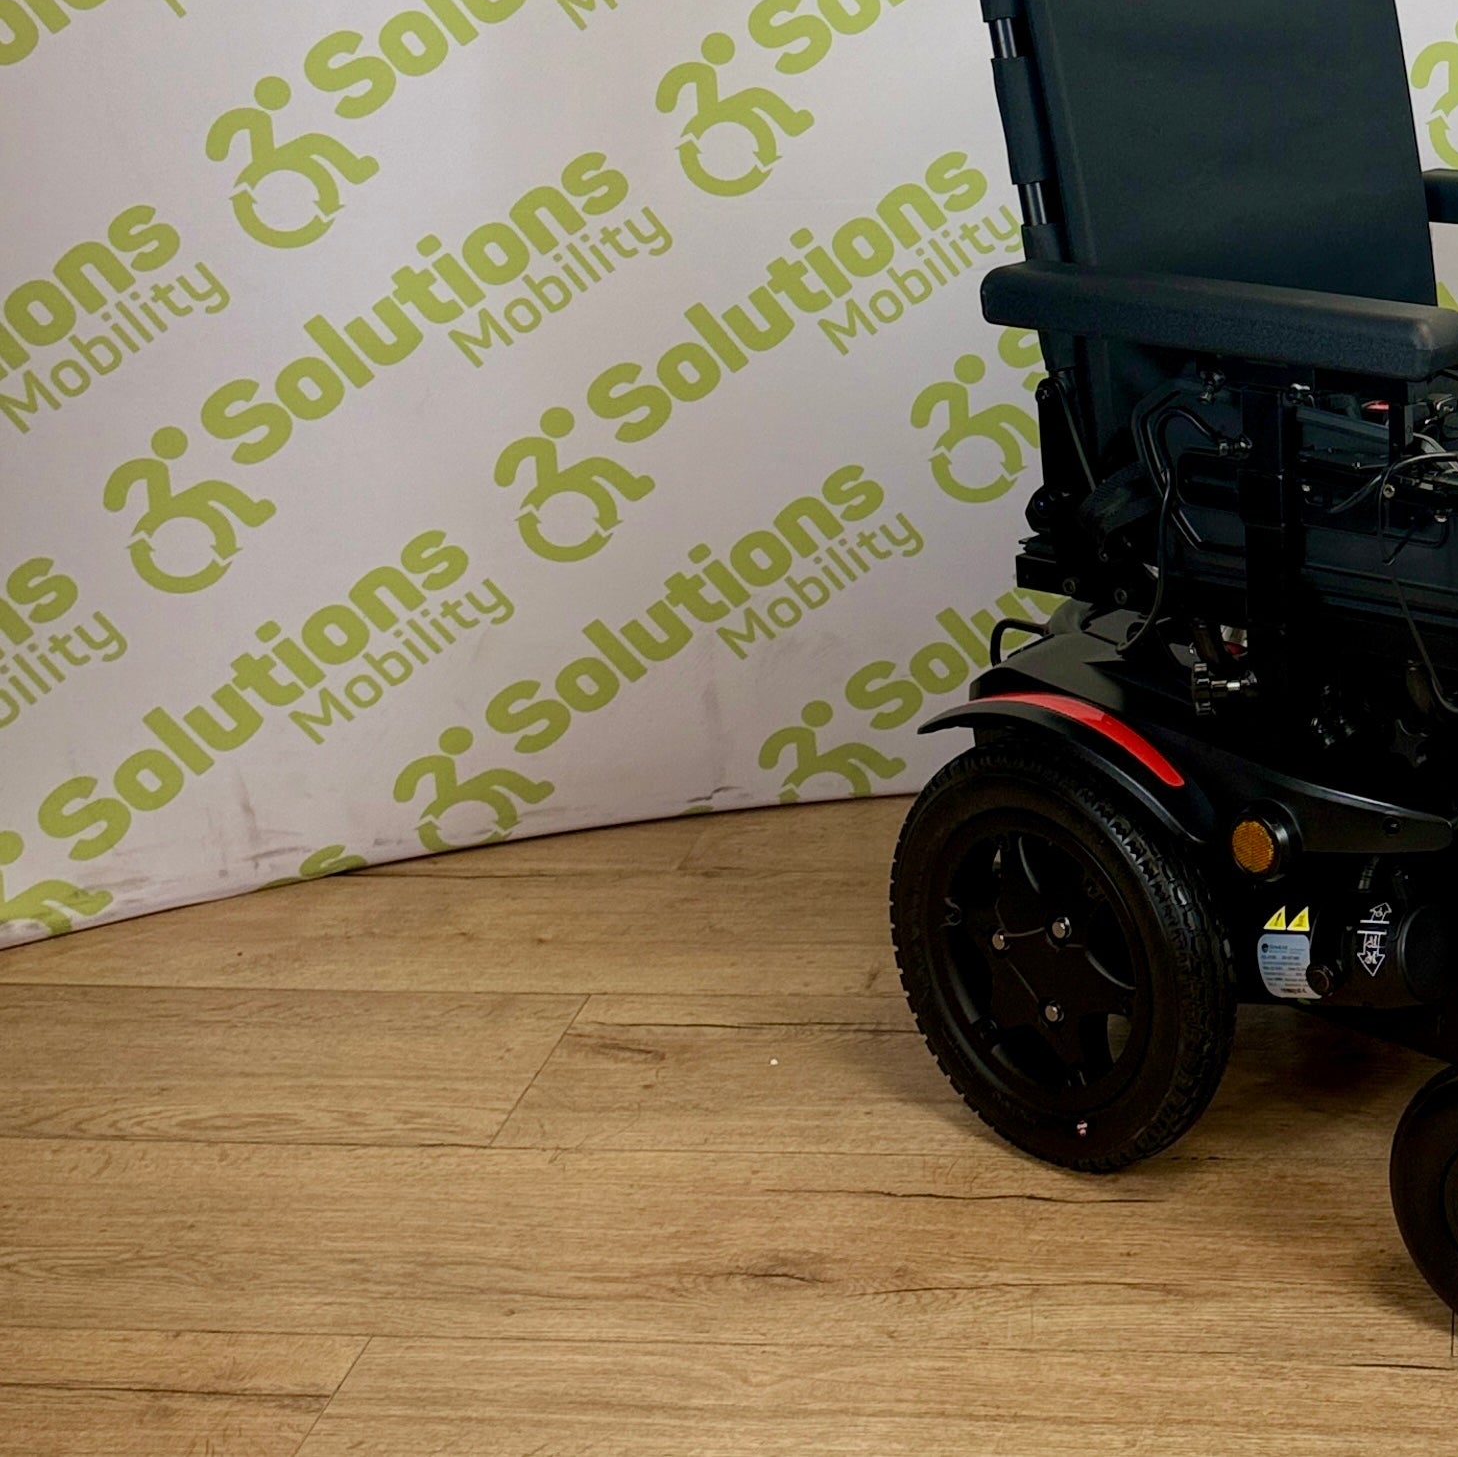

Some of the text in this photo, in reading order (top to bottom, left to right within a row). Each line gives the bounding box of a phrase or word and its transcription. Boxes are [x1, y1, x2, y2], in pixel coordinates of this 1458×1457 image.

[0, 261, 231, 433] Mobility
[201, 152, 629, 464] Solutions
[447, 206, 673, 368] Mobility
[587, 151, 987, 442] Solutions
[817, 206, 1022, 355] Mobility
[288, 578, 515, 744] Mobility
[486, 464, 884, 754] Solutions
[715, 512, 924, 660] Mobility
[38, 529, 469, 861] Solutions
